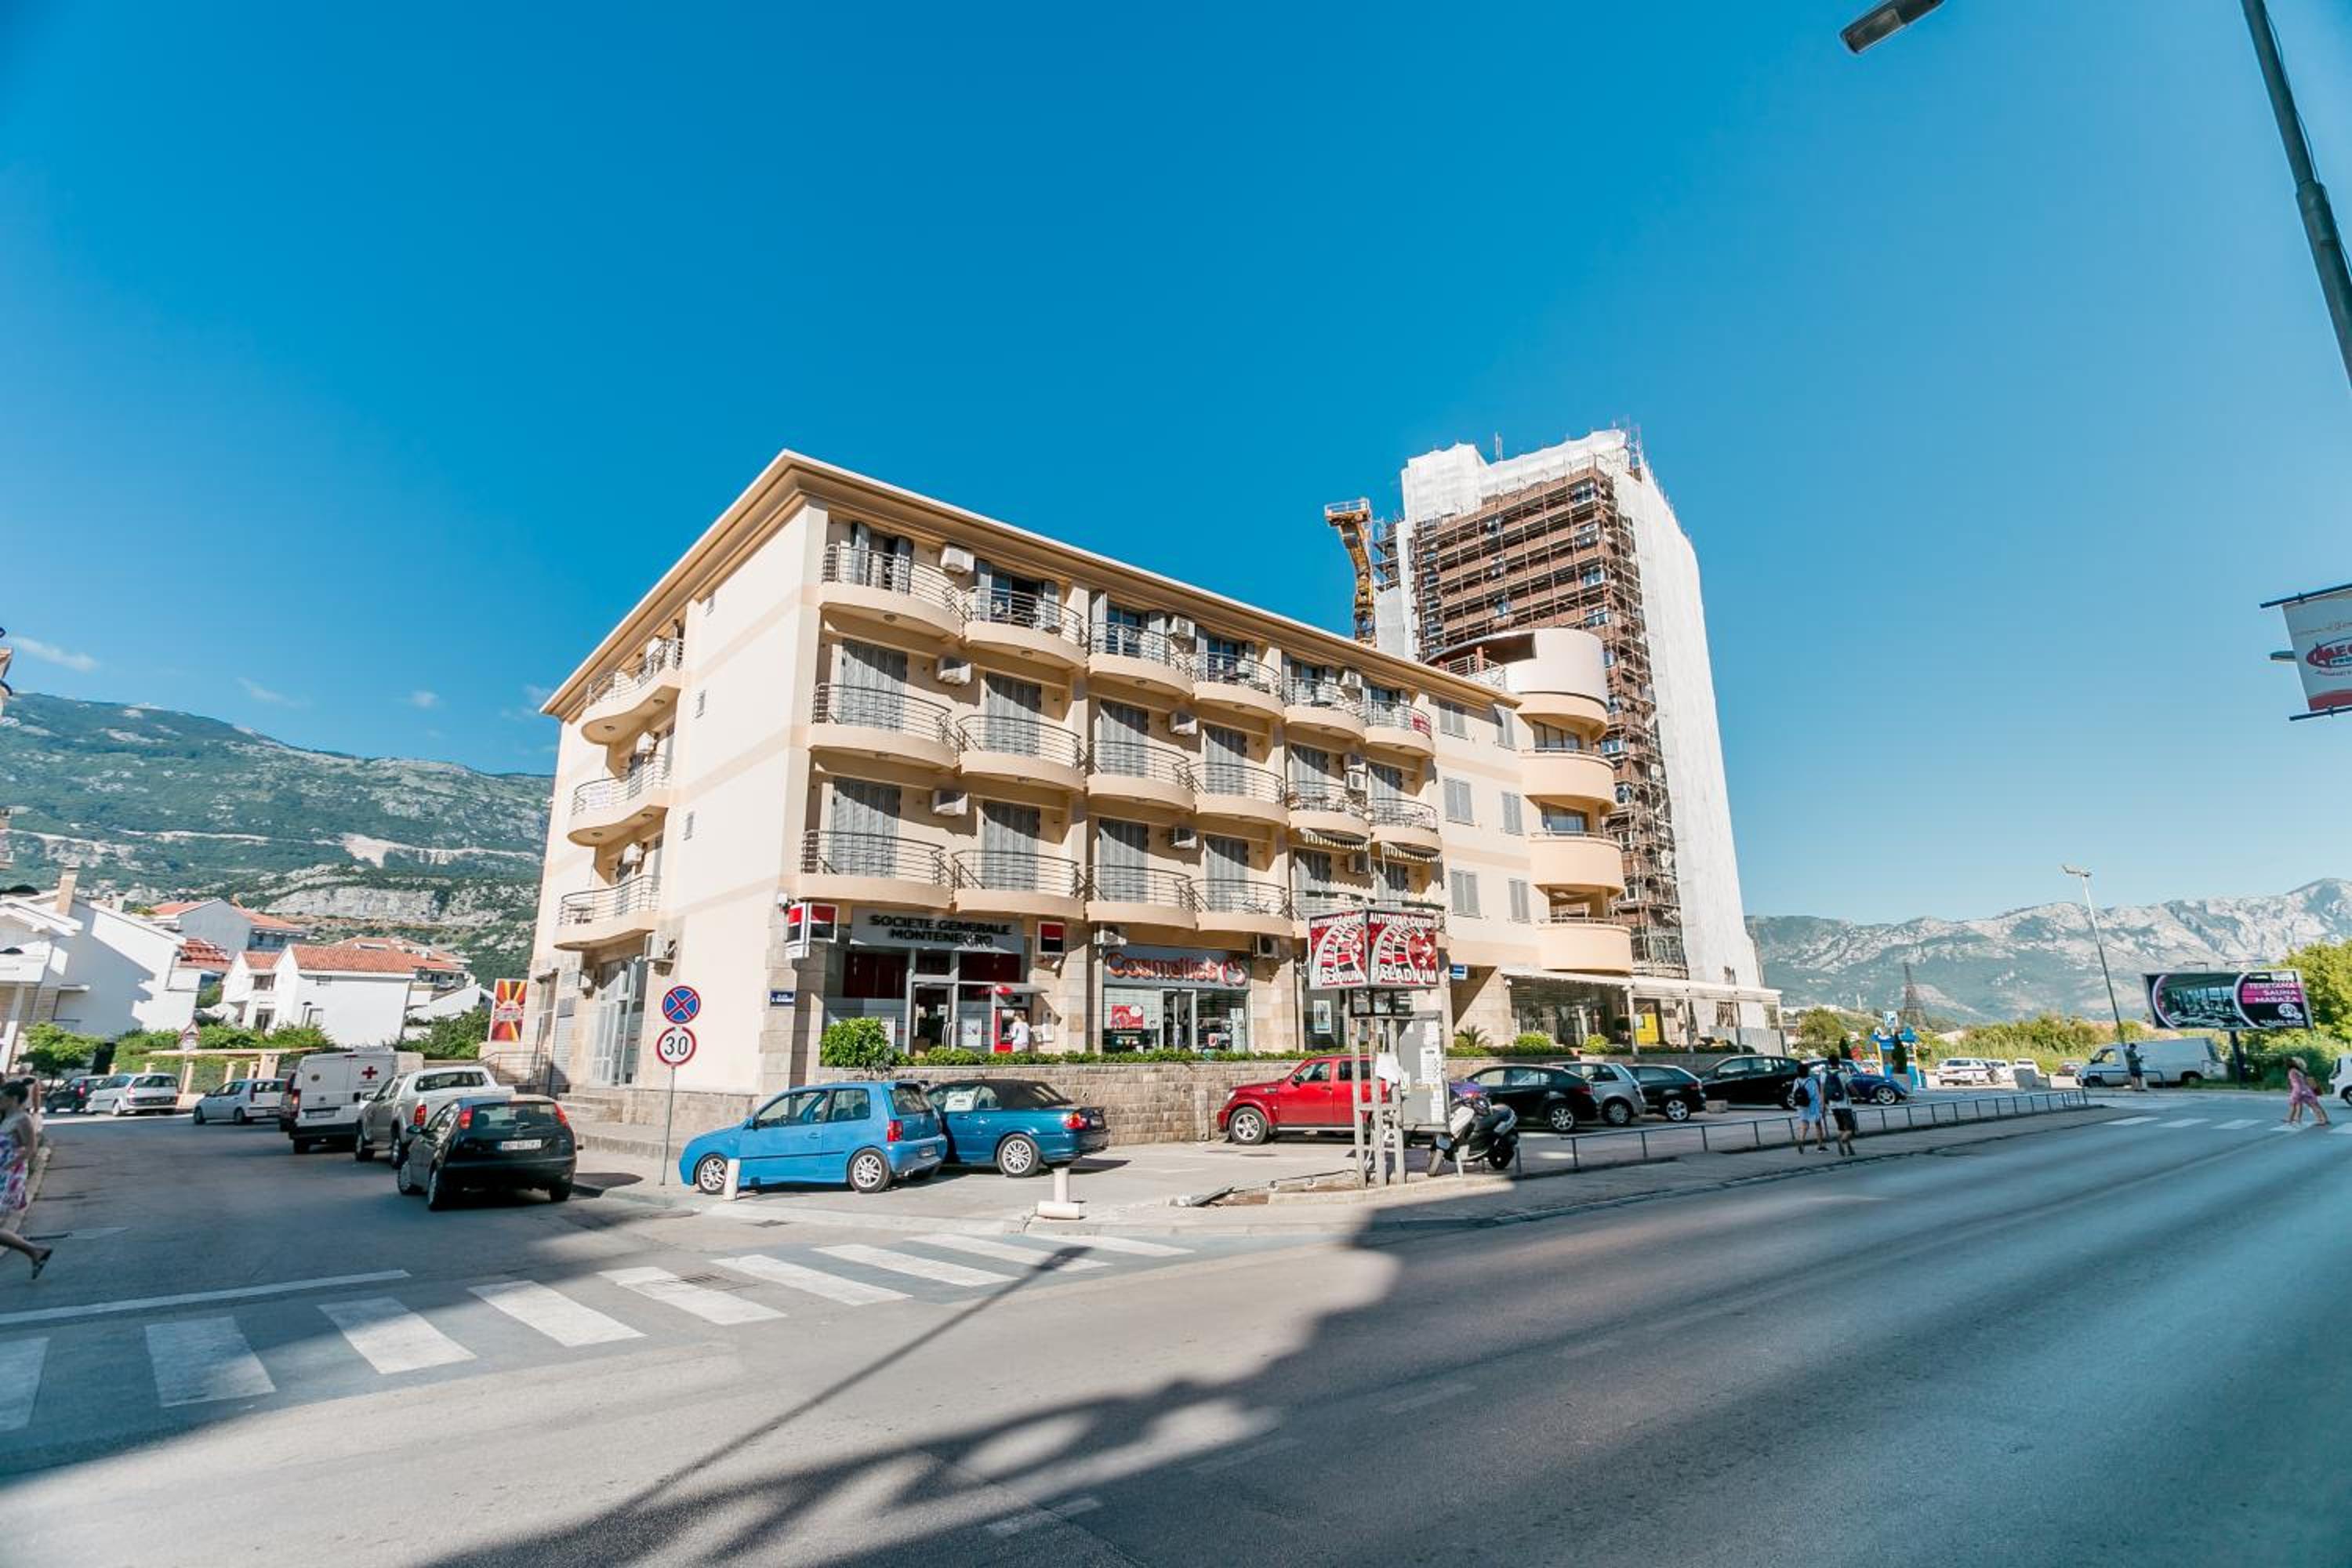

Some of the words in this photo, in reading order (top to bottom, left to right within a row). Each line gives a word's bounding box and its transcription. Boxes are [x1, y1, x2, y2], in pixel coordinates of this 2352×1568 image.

[1369, 913, 1408, 926] AUTOMAT
[889, 928, 993, 946] MONTENEGRO
[664, 1036, 688, 1056] 30
